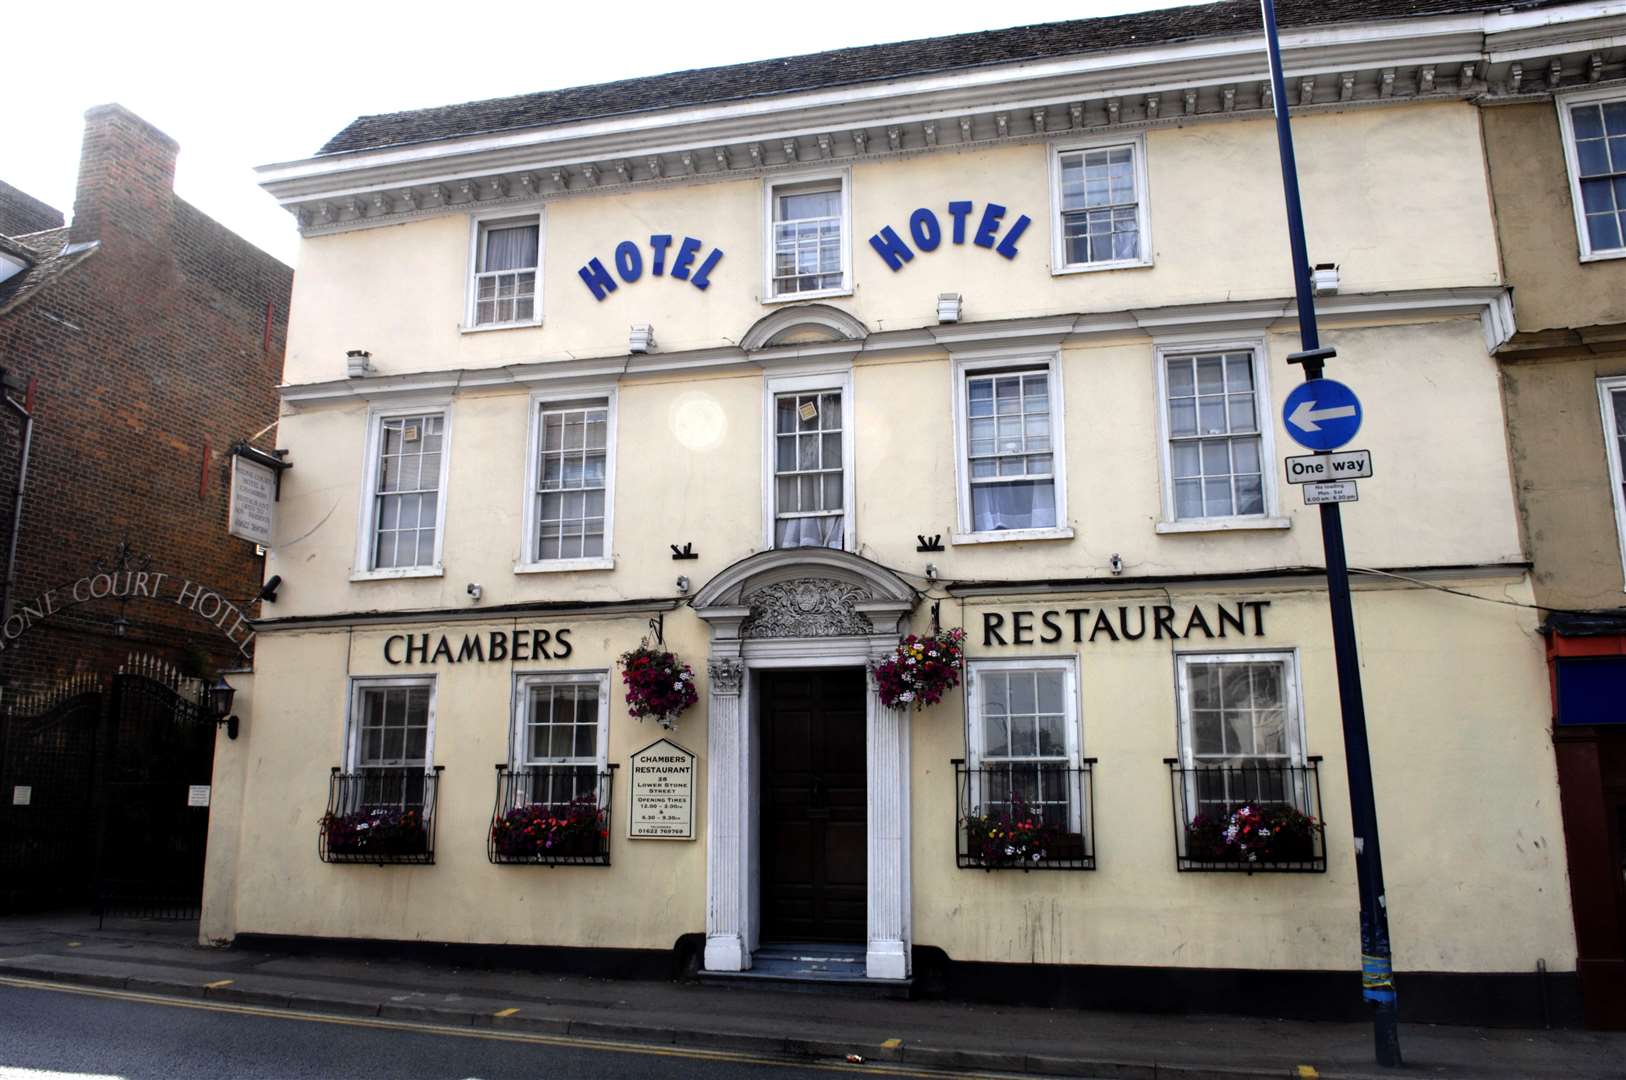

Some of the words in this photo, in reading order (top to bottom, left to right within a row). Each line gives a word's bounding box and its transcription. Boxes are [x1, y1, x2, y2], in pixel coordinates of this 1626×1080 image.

[869, 201, 1031, 273] HOTEL
[578, 234, 724, 302] HOTEL
[1292, 463, 1324, 475] One
[1332, 460, 1364, 472] way
[72, 571, 168, 602] COURT
[176, 580, 256, 659] HOTEL
[982, 601, 1271, 647] RESTAURANT
[384, 628, 573, 665] CHAMBERS
[635, 766, 690, 774] RESTAURANT
